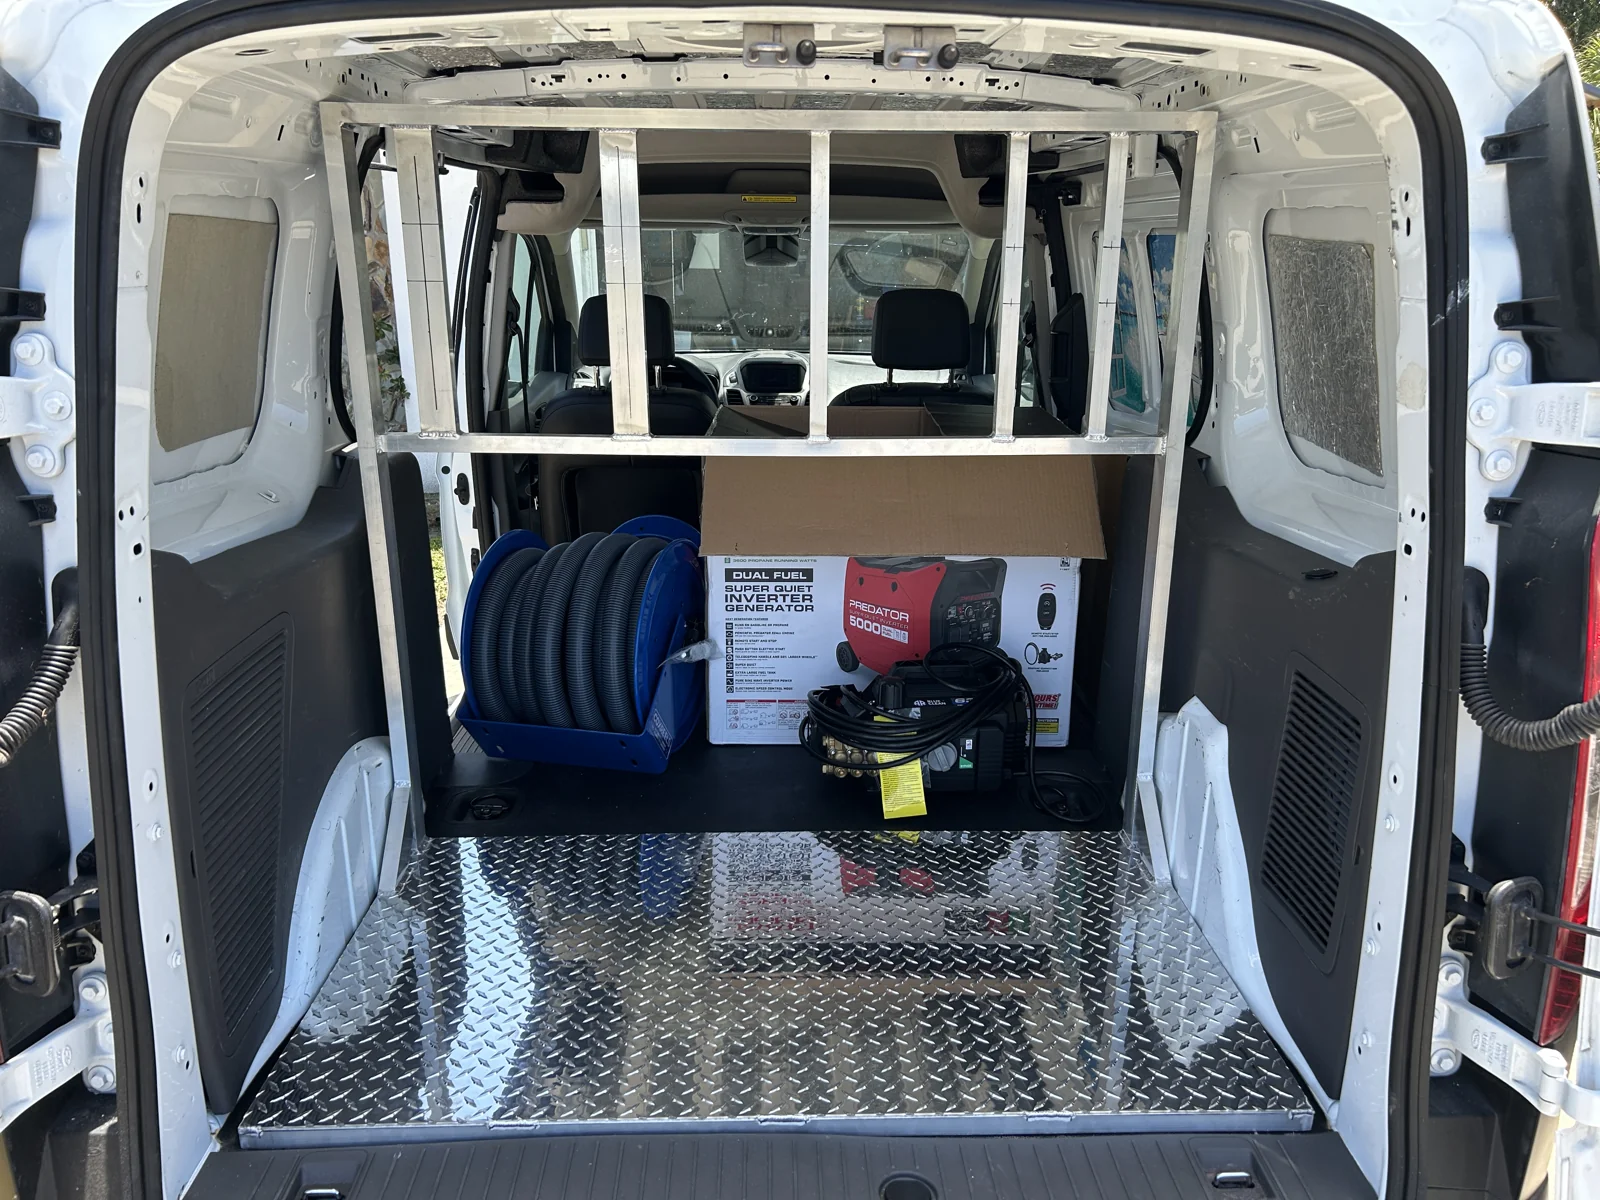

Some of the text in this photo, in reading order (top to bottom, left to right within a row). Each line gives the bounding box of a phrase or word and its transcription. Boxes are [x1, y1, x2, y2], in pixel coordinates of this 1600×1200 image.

[724, 594, 813, 602] INVERTER
[725, 604, 814, 612] GENERATOR
[850, 599, 909, 623] PREDATOR
[850, 615, 881, 635] 5000
